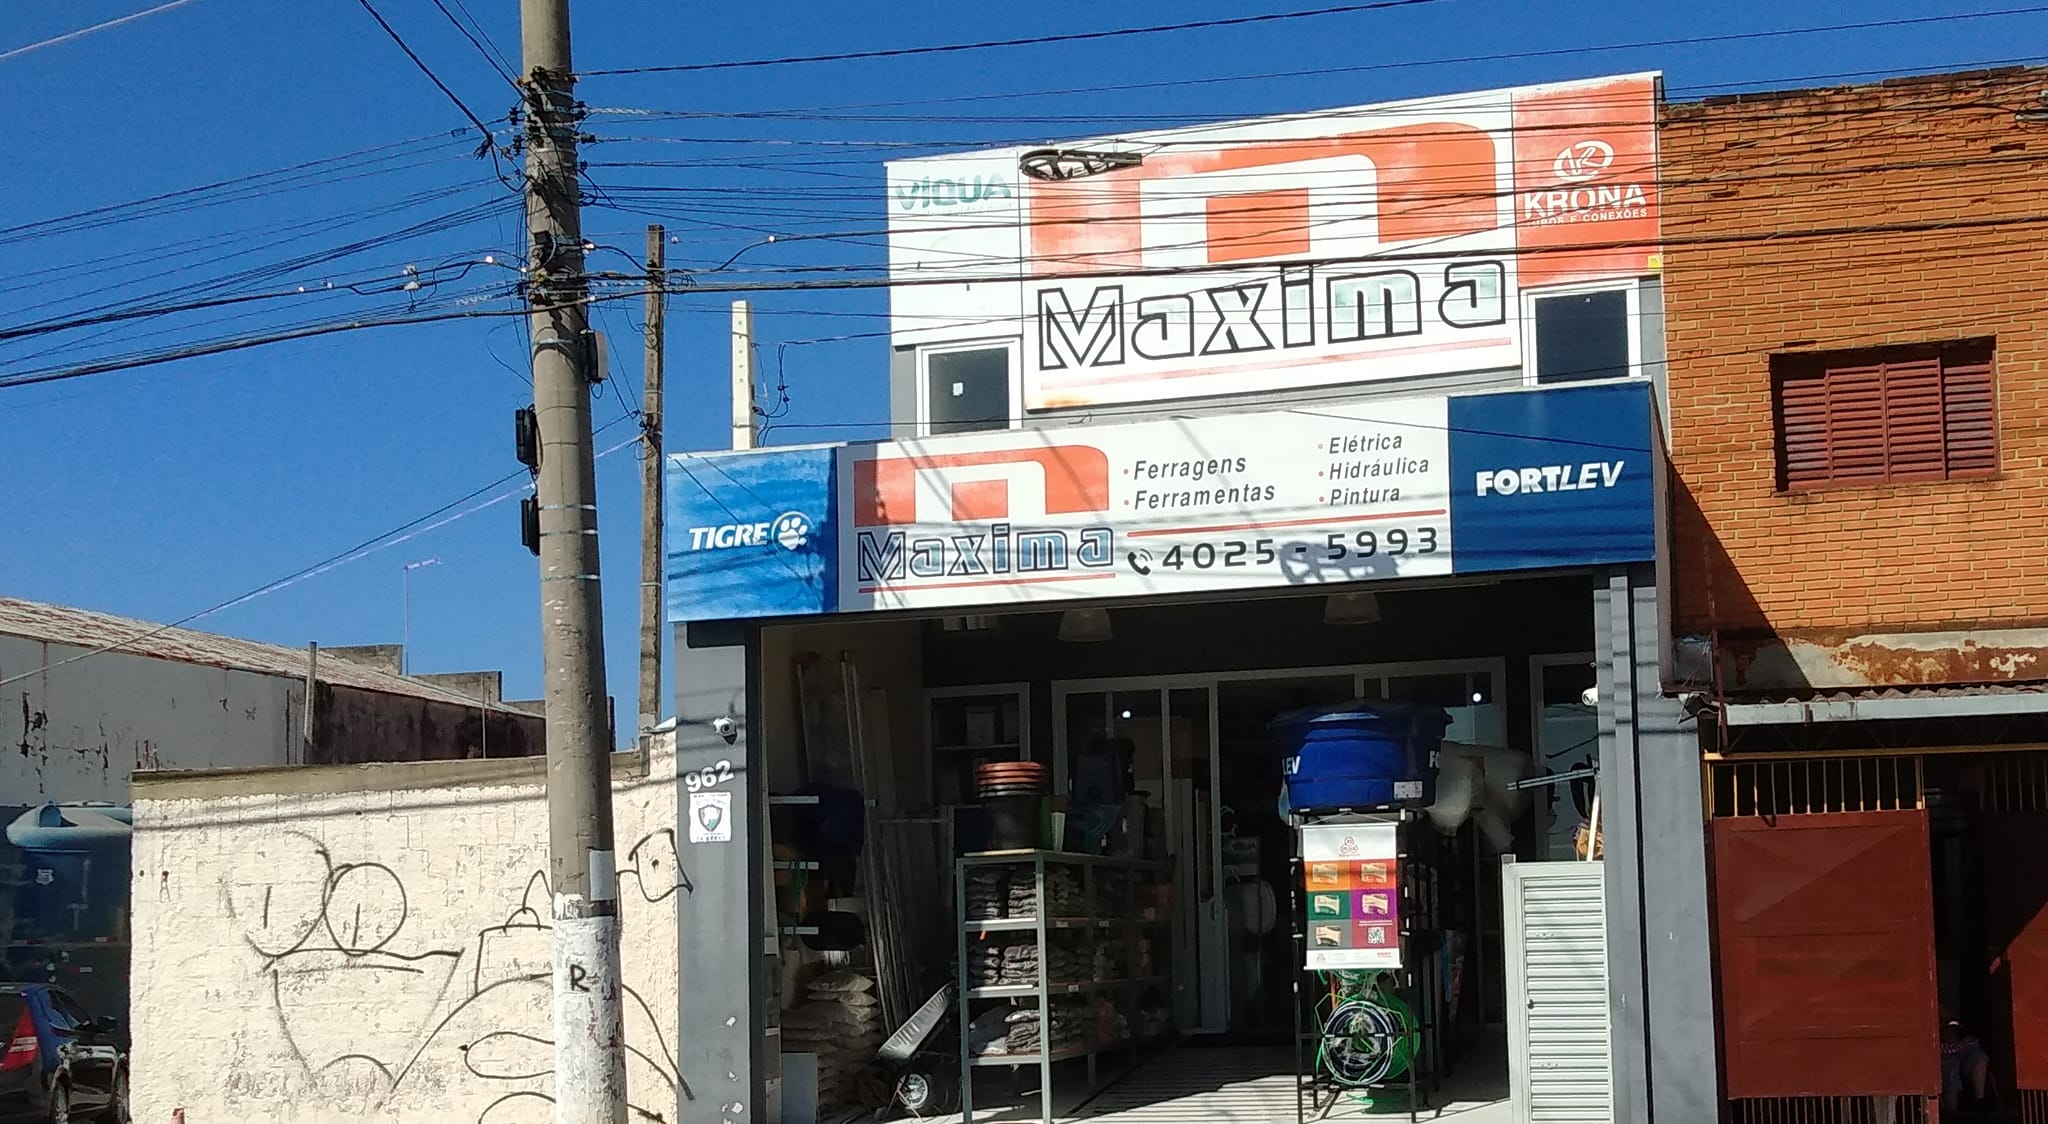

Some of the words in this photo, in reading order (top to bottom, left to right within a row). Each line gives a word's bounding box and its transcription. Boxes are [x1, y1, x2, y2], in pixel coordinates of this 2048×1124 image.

[1524, 184, 1647, 219] KRONA
[1570, 215, 1578, 223] E
[1583, 208, 1648, 222] CONEXÕES
[1038, 260, 1506, 370] Maxima
[1329, 433, 1403, 454] Elétrica
[1134, 456, 1247, 481] Ferragens
[1329, 457, 1429, 480] Hidráulica
[1476, 461, 1625, 497] FORTLEV
[1134, 483, 1275, 510] Ferramentas
[1330, 486, 1400, 506] Pintura
[689, 522, 770, 550] TIGRE
[1162, 539, 1276, 571] 4025
[1327, 527, 1438, 560] 5993
[857, 523, 1113, 583] Maxima
[685, 760, 735, 792] 962
[569, 964, 590, 993] R
